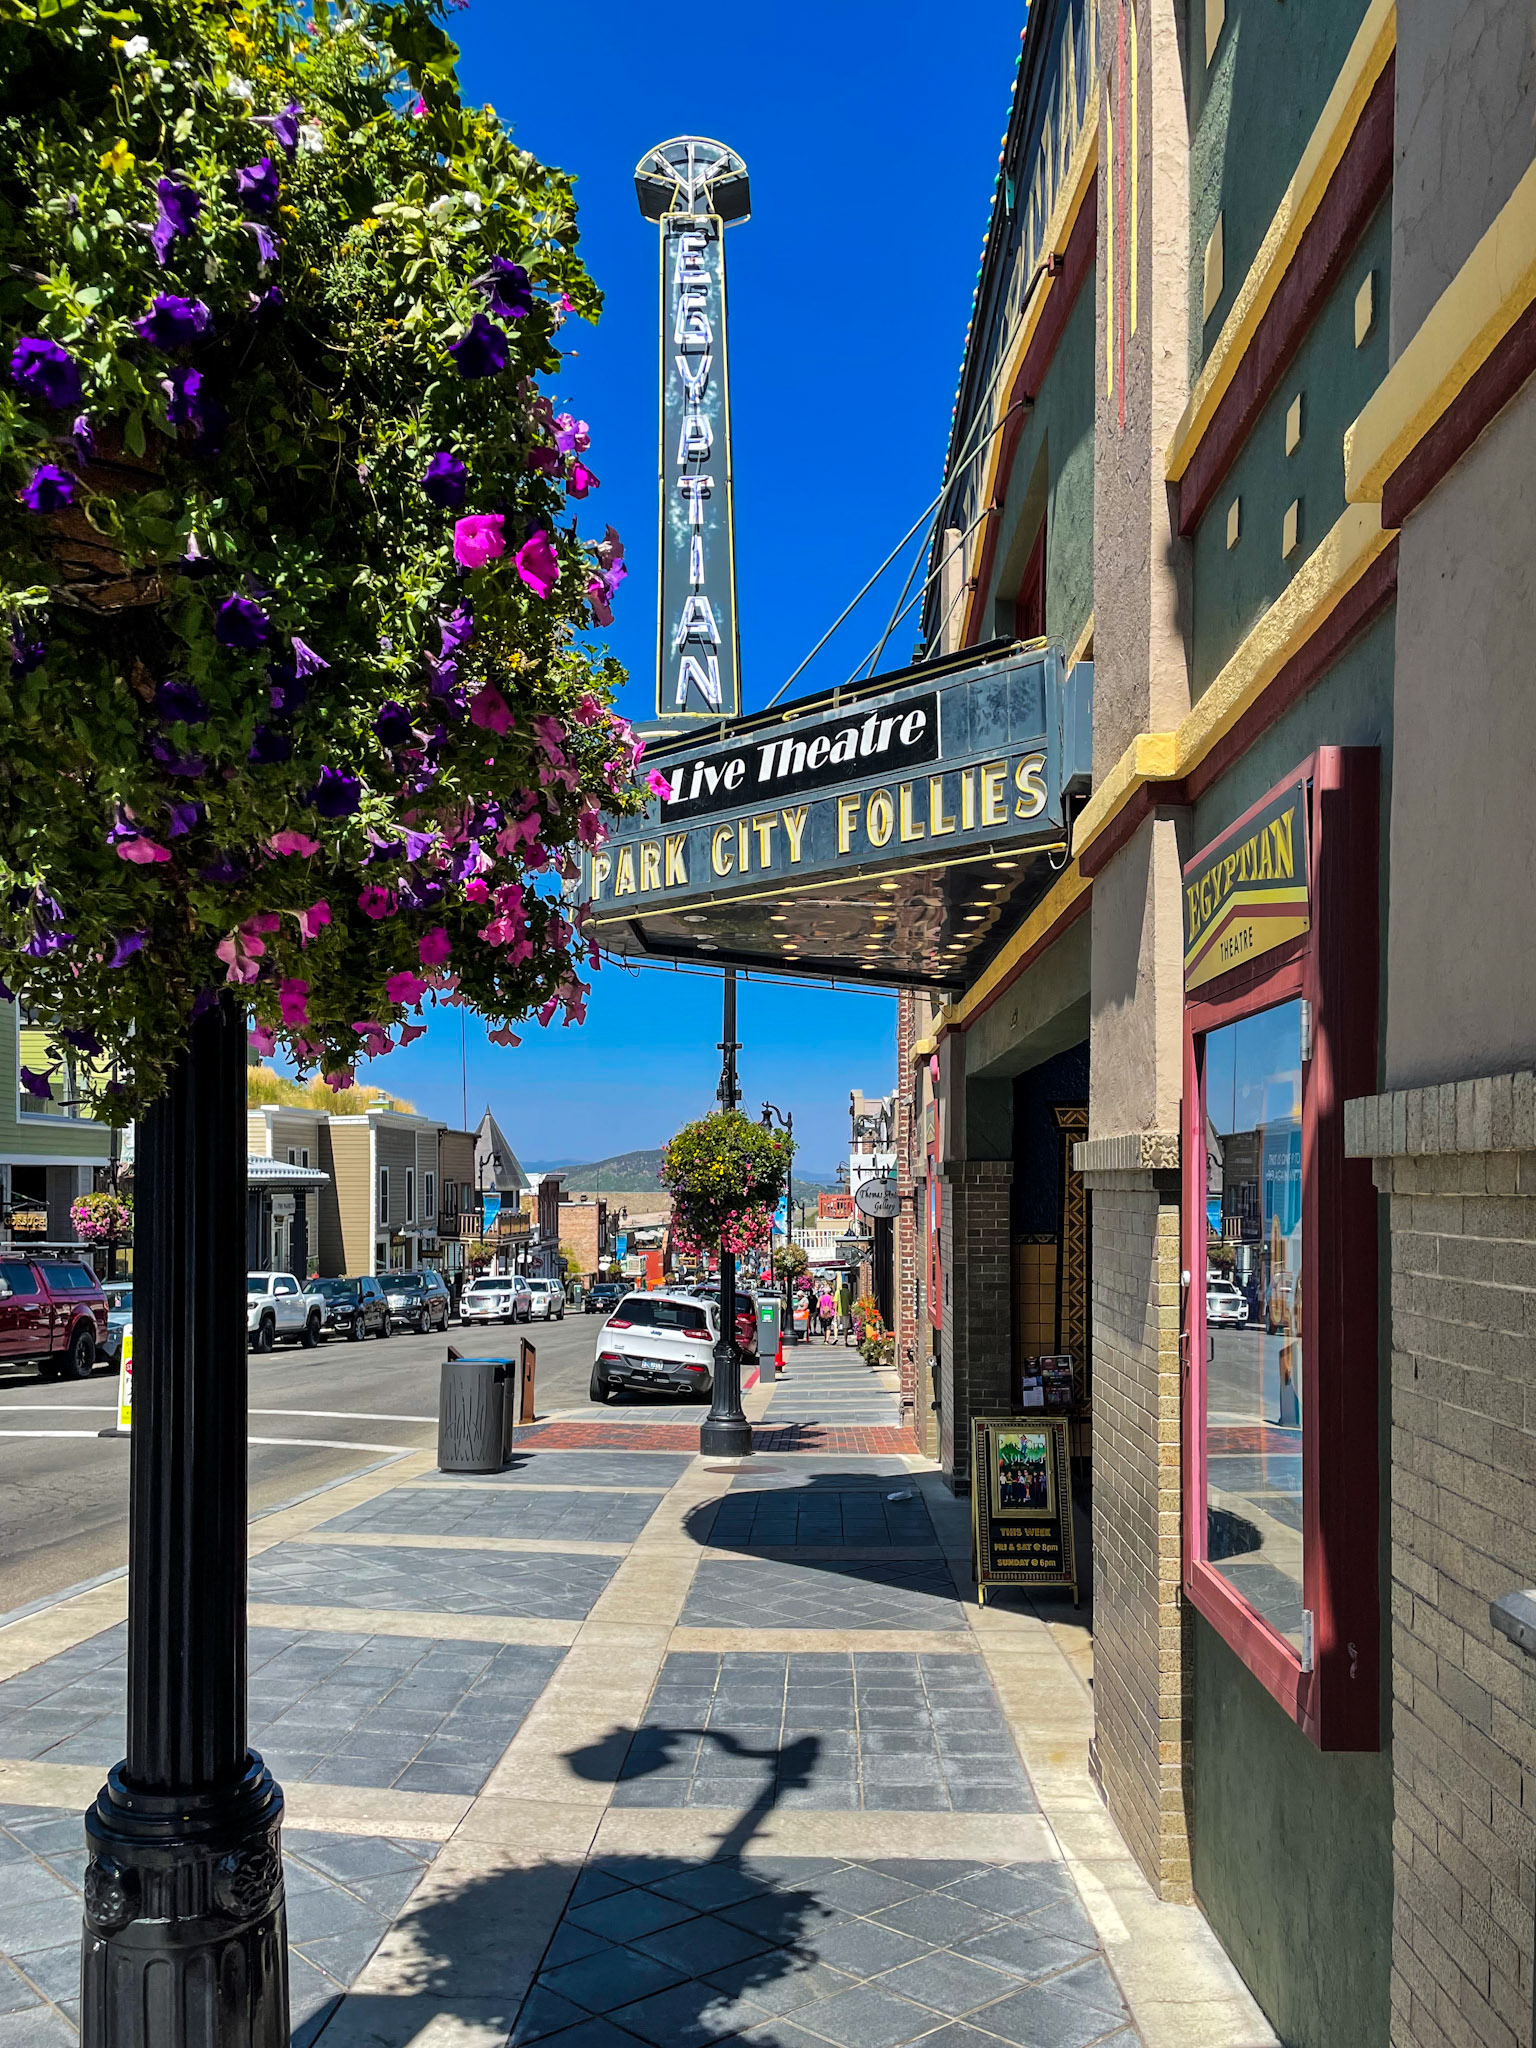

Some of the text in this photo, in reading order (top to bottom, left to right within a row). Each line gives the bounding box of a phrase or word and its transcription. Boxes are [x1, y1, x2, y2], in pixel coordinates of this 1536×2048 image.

[673, 230, 722, 704] EGYPTIAN
[667, 709, 928, 806] Live Theatre
[590, 753, 1048, 901] PARK CITY FOLLIES
[1186, 806, 1295, 945] EGYPTIAN
[1220, 925, 1254, 962] THEATRE
[994, 1543, 1007, 1551] FRI
[1016, 1543, 1032, 1551] SAT
[1033, 1543, 1041, 1551] @
[1042, 1543, 1058, 1552] 8pm
[997, 1558, 1056, 1568] SUNDAY @ 6pm
[1000, 1528, 1051, 1537] THIS WEEK
